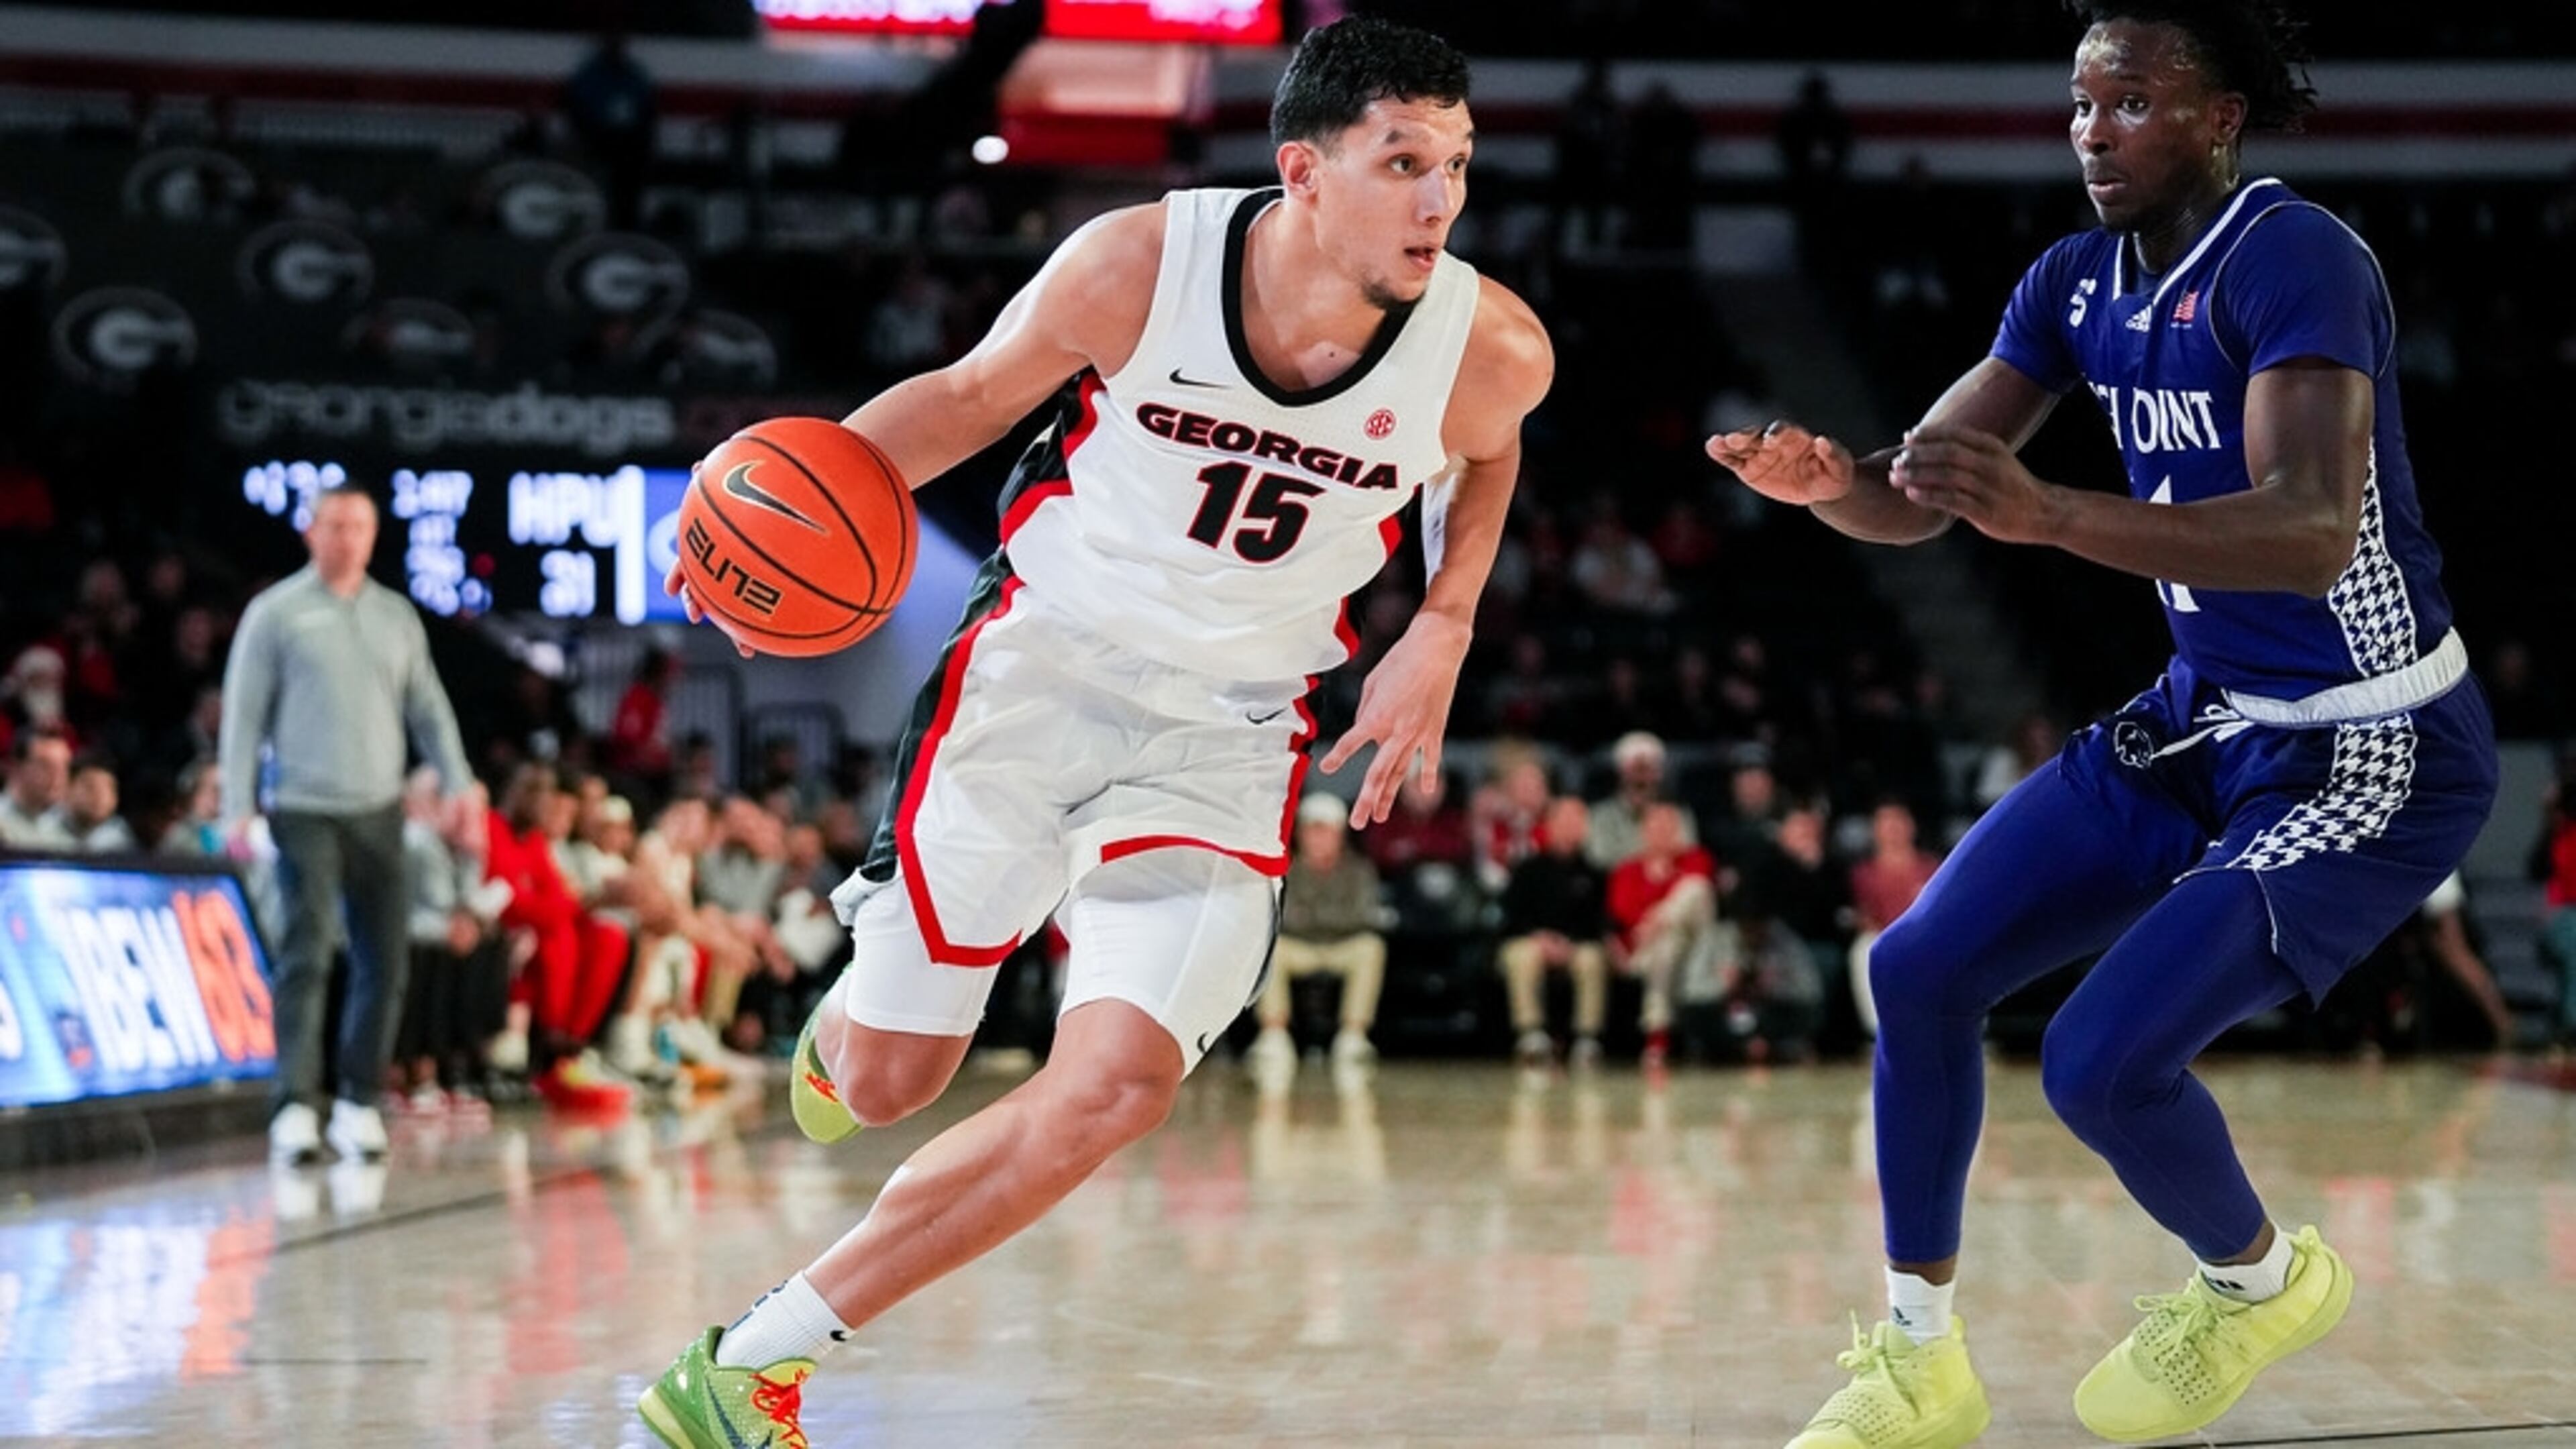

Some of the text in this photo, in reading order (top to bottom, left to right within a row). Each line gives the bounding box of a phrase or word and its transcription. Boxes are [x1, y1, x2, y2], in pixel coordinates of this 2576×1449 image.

[1136, 402, 1399, 490] GEORGIA
[2131, 386, 2222, 453] OINT
[1187, 460, 1328, 564] 15
[685, 517, 784, 615] ELITE
